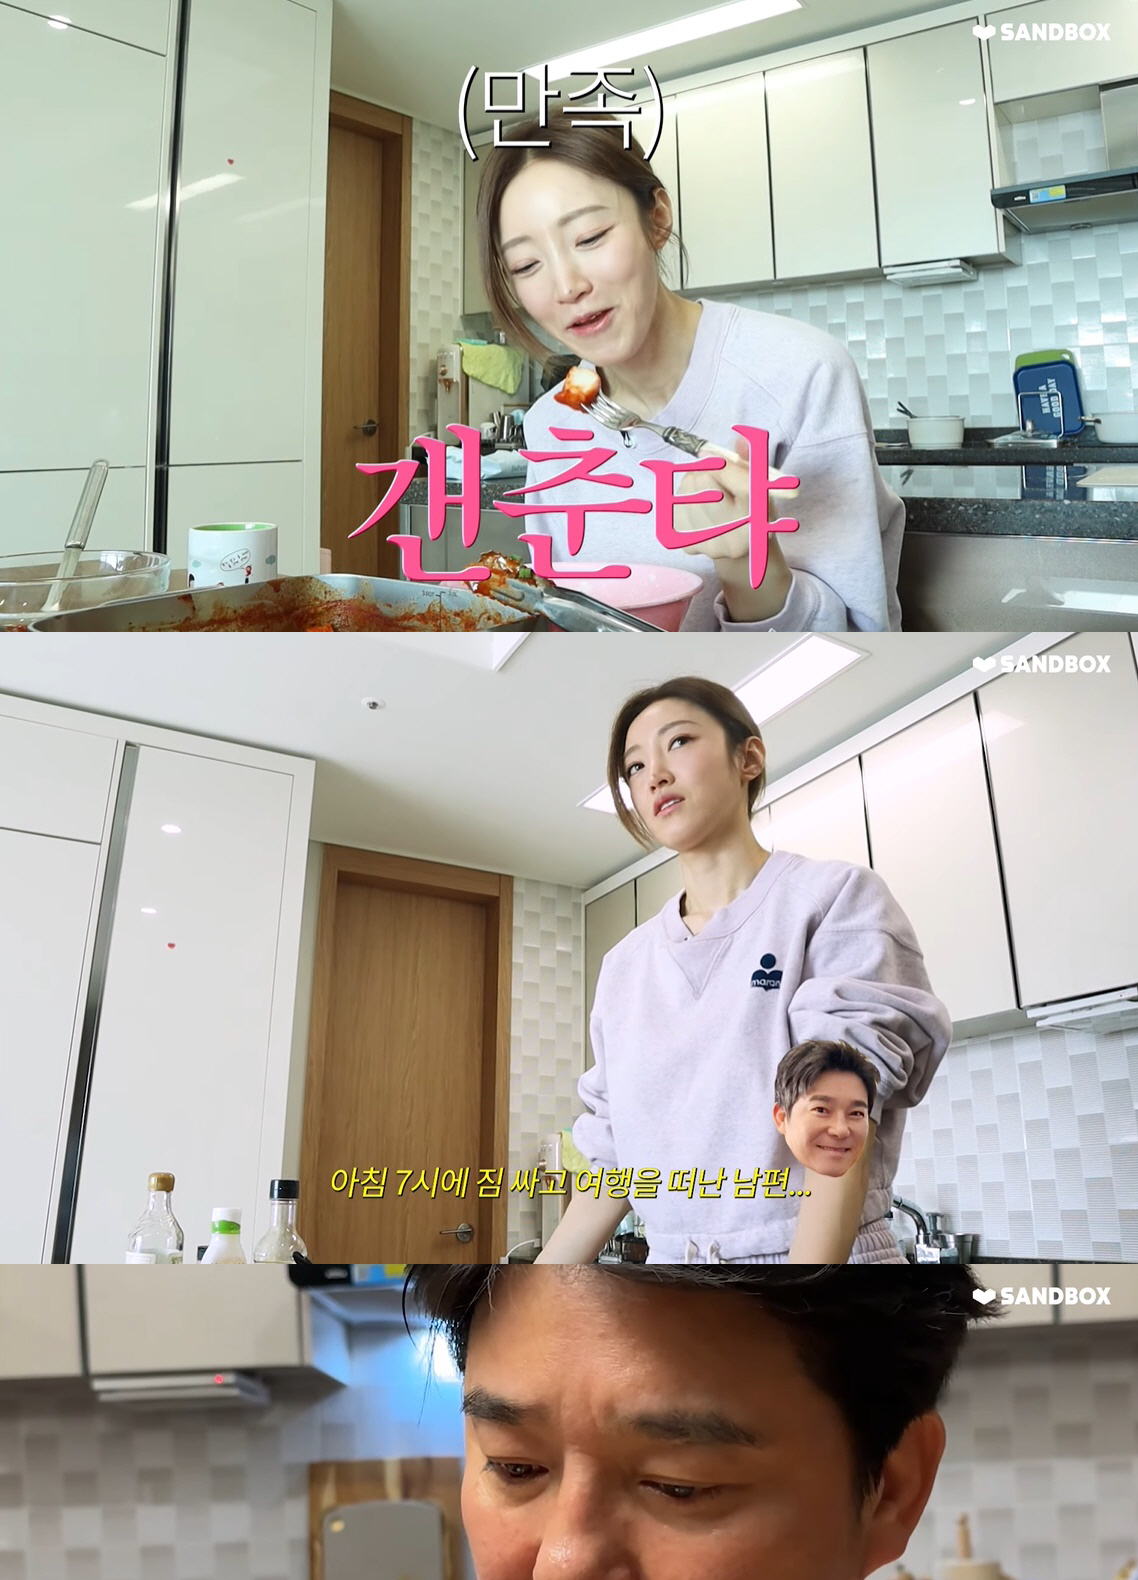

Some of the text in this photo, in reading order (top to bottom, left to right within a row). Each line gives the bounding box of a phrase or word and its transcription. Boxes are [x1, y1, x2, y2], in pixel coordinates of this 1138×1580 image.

[1040, 392, 1051, 414] HAVE
[1047, 378, 1062, 418] GOOD DAY
